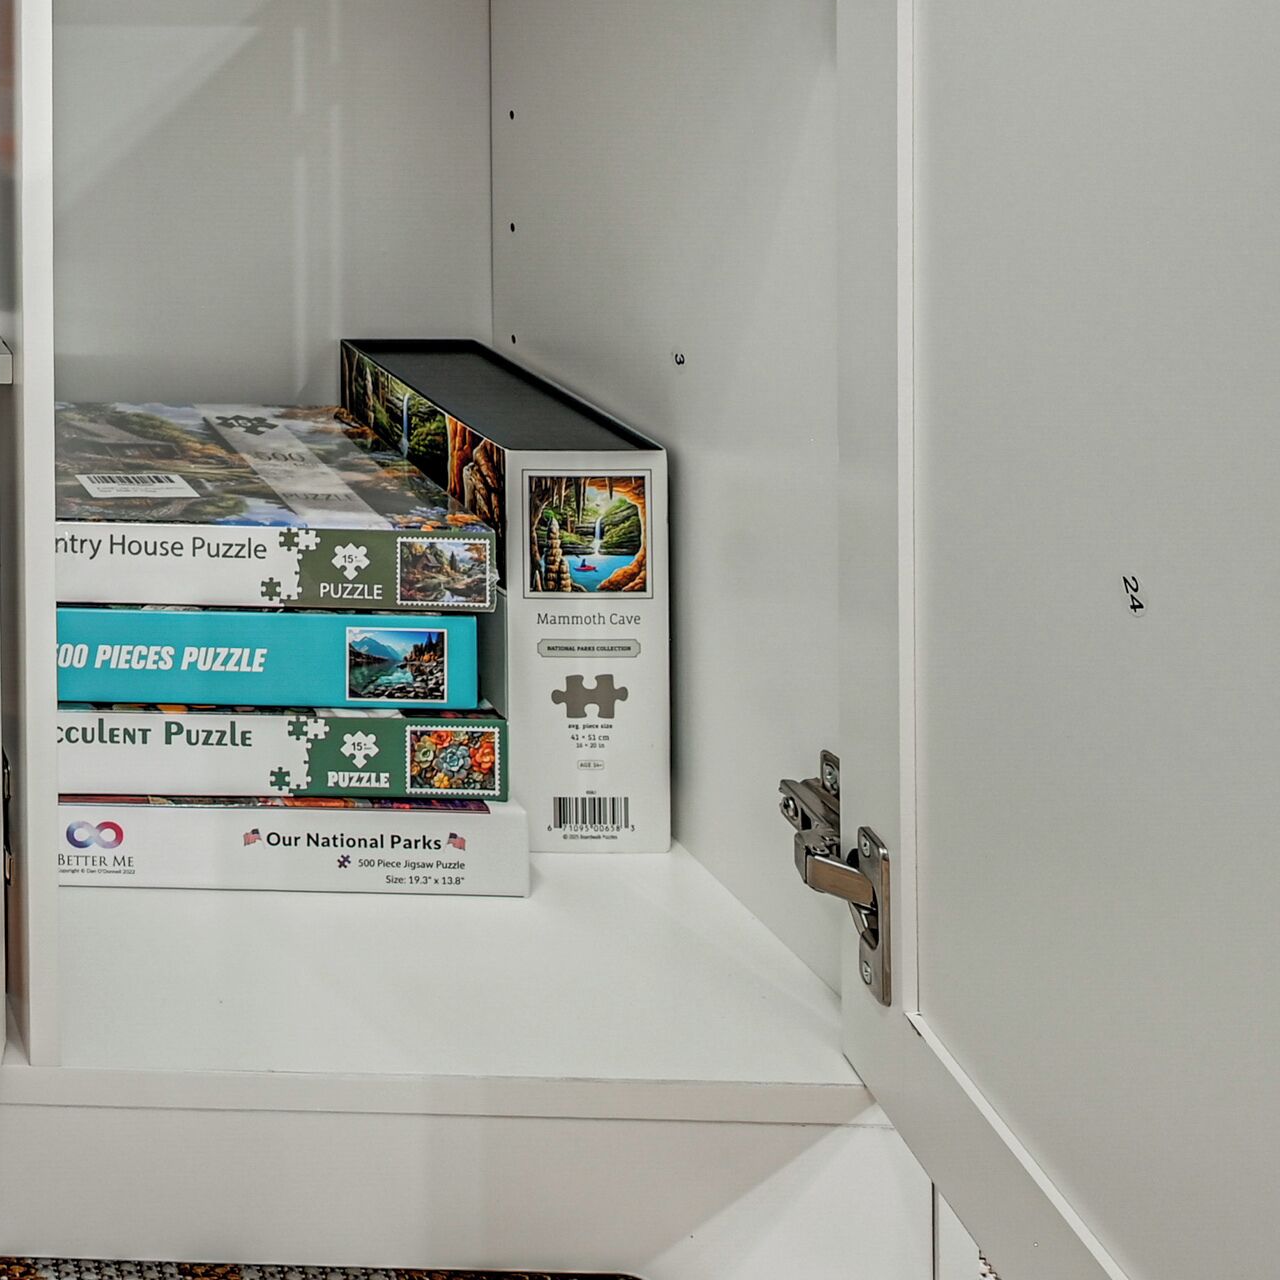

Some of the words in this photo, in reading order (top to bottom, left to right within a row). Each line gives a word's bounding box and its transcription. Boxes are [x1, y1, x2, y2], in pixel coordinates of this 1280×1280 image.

[109, 534, 185, 557] House
[192, 537, 267, 560] Puzzle
[319, 583, 383, 600] PUZZLE
[1122, 575, 1144, 613] 24
[537, 613, 606, 625] Mammoth
[609, 613, 641, 625] Cave
[56, 643, 89, 668] 00
[94, 644, 175, 670] PIECES
[181, 646, 268, 673] PUZZLE
[327, 771, 390, 789] PUZZLE
[547, 824, 552, 832] 6
[631, 824, 635, 832] 3
[266, 832, 301, 847] Our
[307, 833, 384, 849] National
[391, 834, 442, 850] Parks
[358, 858, 375, 868] 500
[377, 858, 401, 868] Piece
[404, 859, 434, 870] Jigsaw
[436, 860, 466, 870] Puzzle
[385, 875, 406, 885] Size:
